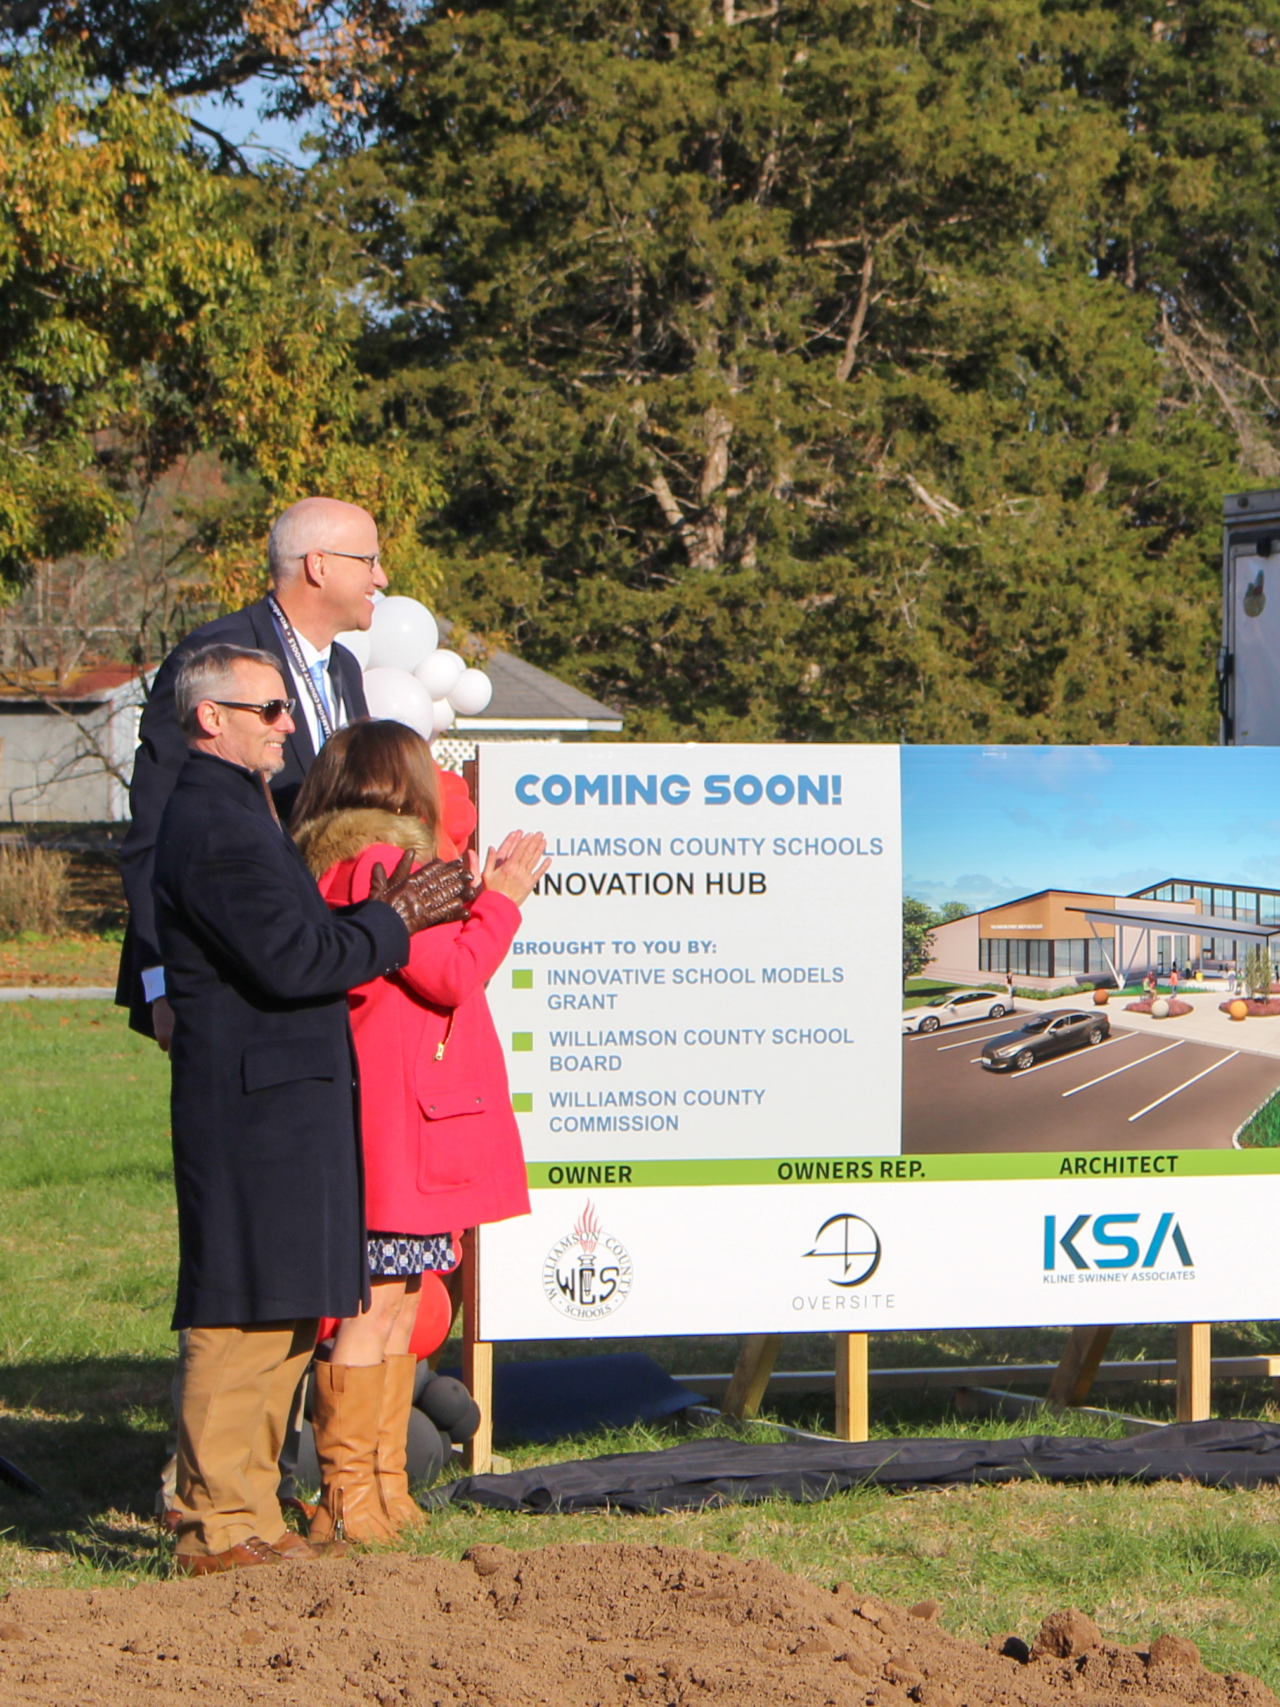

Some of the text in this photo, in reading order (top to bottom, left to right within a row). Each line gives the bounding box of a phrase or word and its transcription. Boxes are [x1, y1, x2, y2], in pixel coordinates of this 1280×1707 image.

[288, 638, 307, 672] SCHOOLS
[303, 673, 320, 703] COUNTY
[515, 774, 841, 805] COMING SOON!
[543, 837, 883, 856] LLIAMSON COUNTY SCHOOLS
[532, 872, 766, 896] NOVATION HUB
[512, 941, 716, 956] BROUGHT TO YOU BY:
[548, 967, 845, 985] INNOVATIVE SCHOOL MODELS
[548, 994, 617, 1010] GRANT
[550, 1028, 854, 1047] WILLIAMSON COUNTY SCHOOL
[550, 1055, 622, 1071] BOARD
[549, 1089, 765, 1107] WILLIAMSON COUNTY
[550, 1115, 680, 1133] COMMISSION
[778, 1161, 925, 1182] OWNERS REP.
[1060, 1155, 1178, 1174] ARCHITECT
[549, 1166, 633, 1185] OWNER
[1044, 1213, 1193, 1270] KSA
[544, 1231, 632, 1300] WILLIAMSON COUNTY
[1044, 1271, 1195, 1283] KLINE SWINNEY ASSOCIATES
[564, 1304, 612, 1318] SCHOOLS
[793, 1295, 894, 1311] OVERSITE
